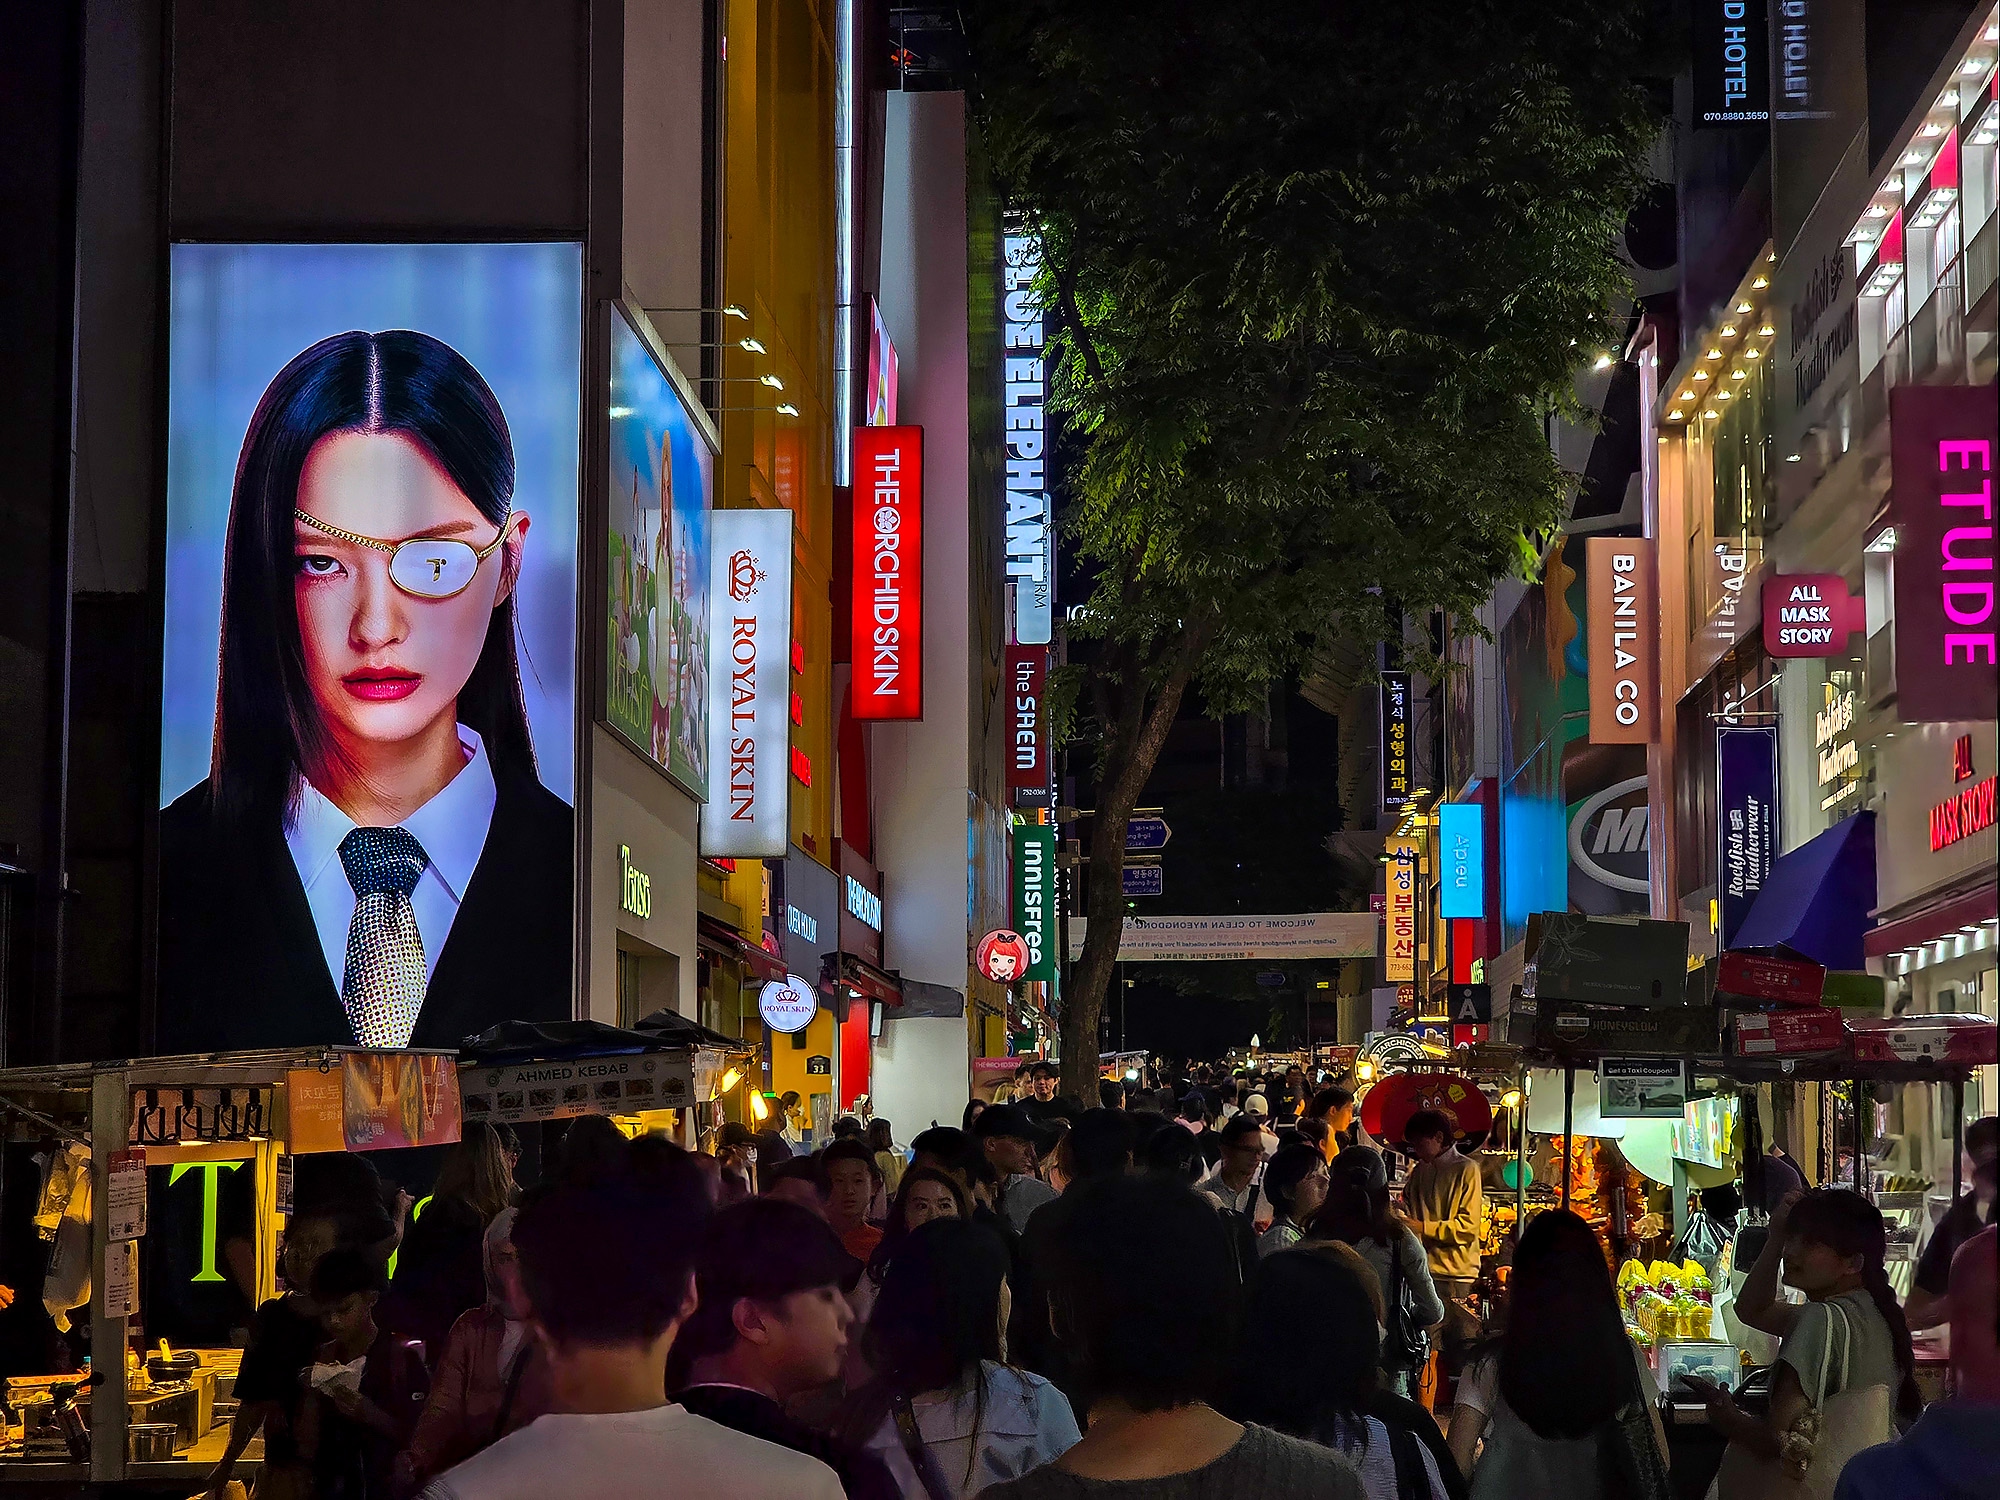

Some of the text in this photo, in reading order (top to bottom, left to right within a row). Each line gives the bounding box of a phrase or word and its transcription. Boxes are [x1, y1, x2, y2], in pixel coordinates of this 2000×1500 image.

[1723, 26, 1747, 108] HOTEL
[1703, 111, 1769, 121] 070.8880.3650
[1003, 234, 1044, 349] BLUE
[1003, 356, 1045, 583] ELEPHANT
[1938, 439, 1996, 666] ETUDE
[1780, 606, 1831, 623] MASK
[1789, 585, 1822, 602] ALL
[1612, 554, 1639, 726] BANILA CO
[1779, 628, 1833, 644] STORY
[1016, 662, 1035, 692] the
[1390, 680, 1405, 720] 노정식
[730, 615, 757, 824] ROYAL SKIN
[1389, 722, 1408, 793] 성형외과
[1953, 733, 1973, 784] ALL
[1591, 806, 1648, 854] M
[1929, 794, 1960, 852] MASK
[1961, 775, 1997, 839] STORY
[1727, 832, 1746, 898] Rockfish
[1744, 795, 1761, 891] Weatherwear
[1392, 846, 1415, 960] 삼성 부동산
[764, 1005, 811, 1013] ROYAL SKIN
[516, 1063, 629, 1083] AHMED KEBAB
[813, 1064, 824, 1074] 33
[1642, 1067, 1673, 1075] Coupon!
